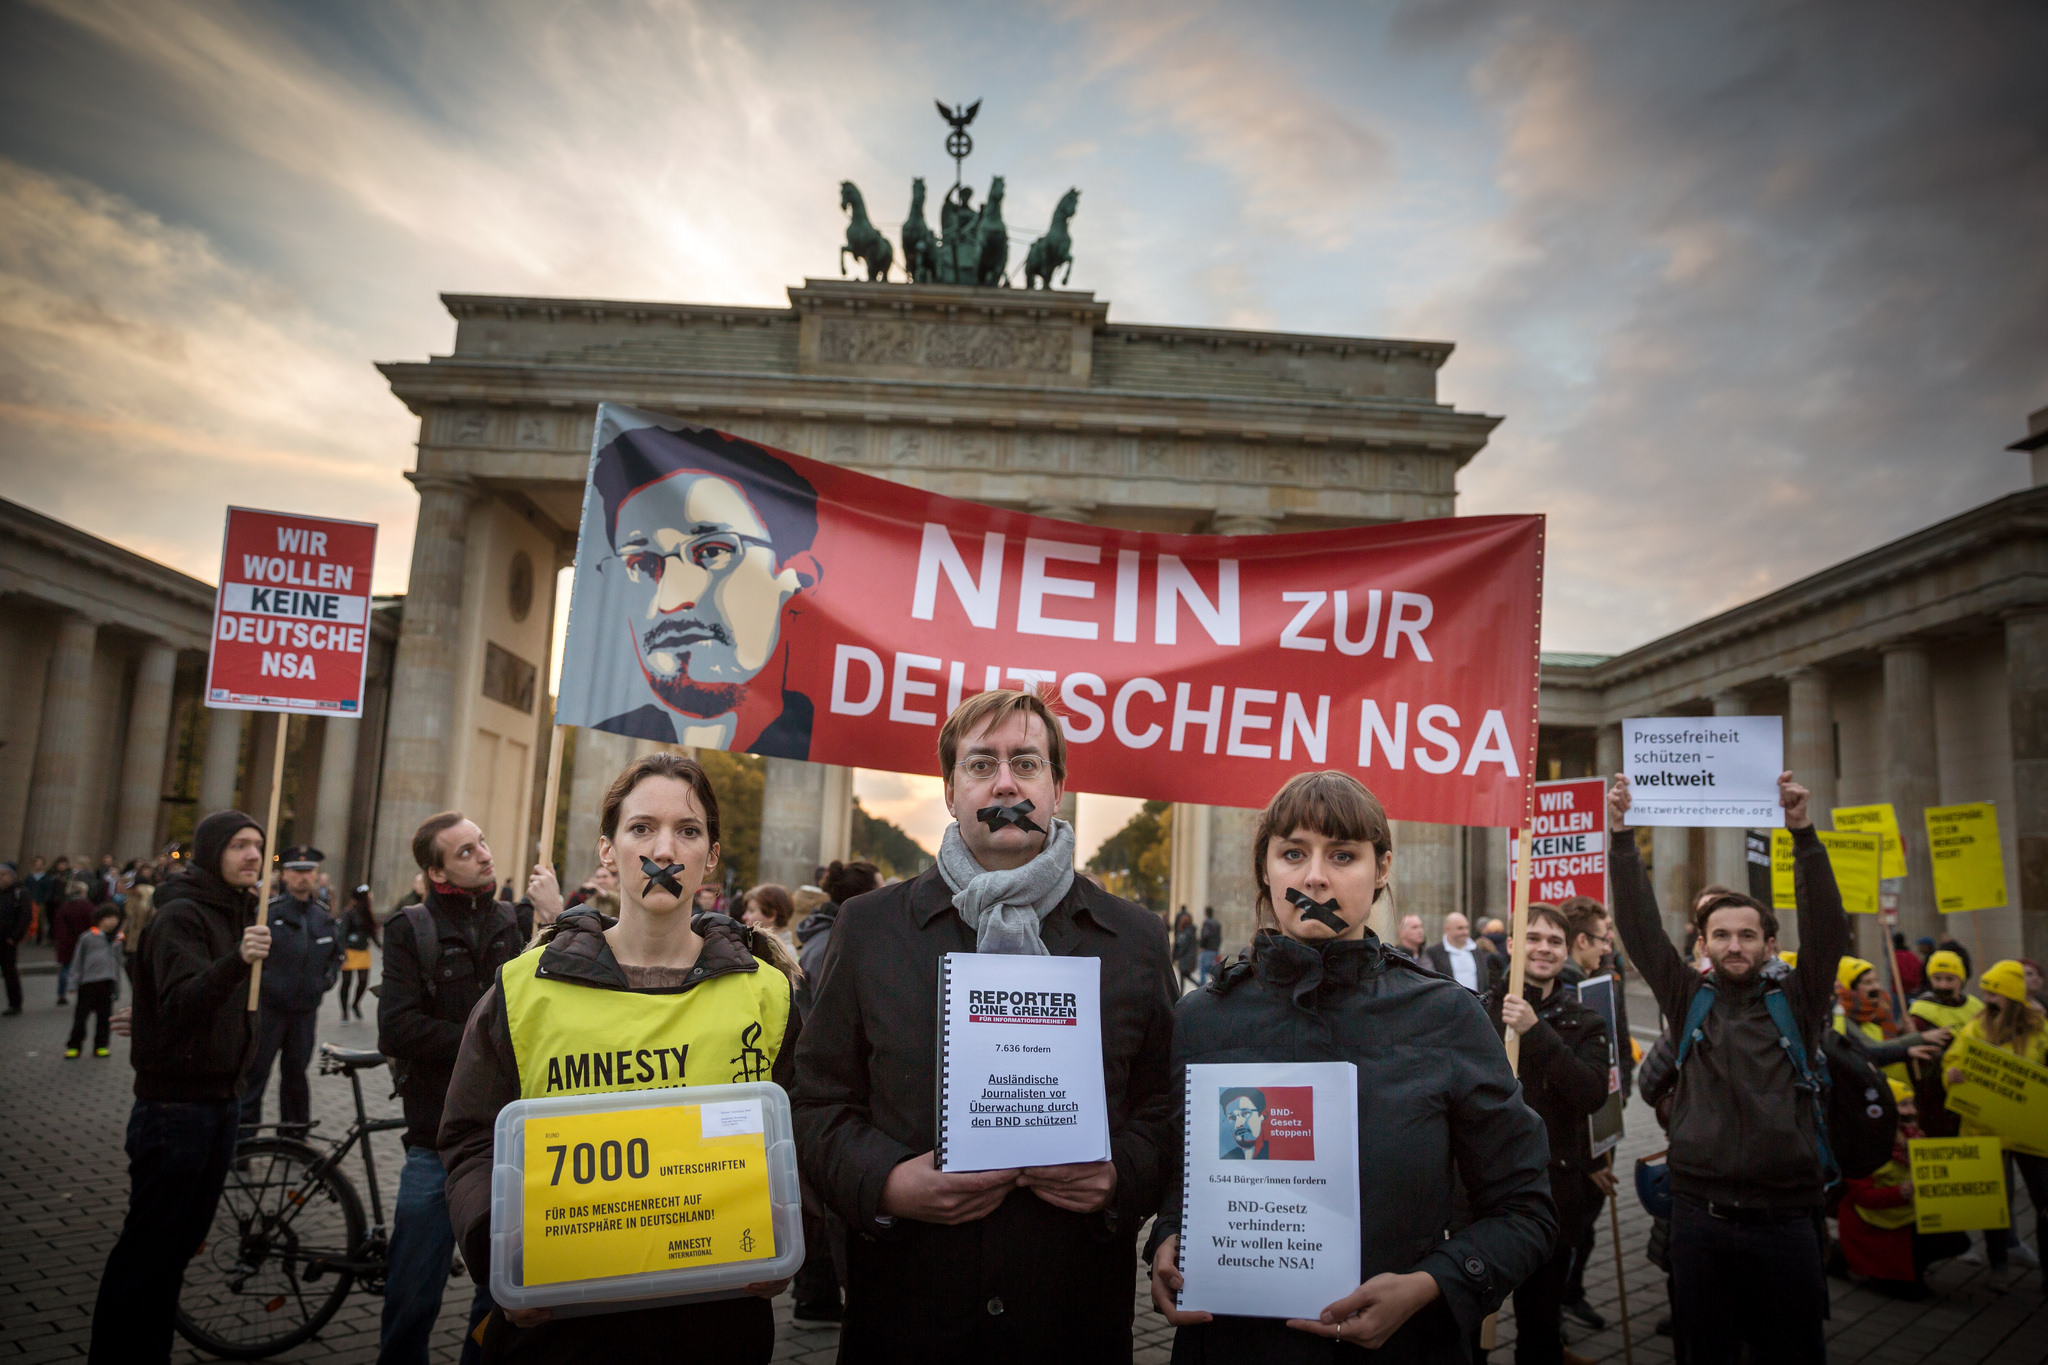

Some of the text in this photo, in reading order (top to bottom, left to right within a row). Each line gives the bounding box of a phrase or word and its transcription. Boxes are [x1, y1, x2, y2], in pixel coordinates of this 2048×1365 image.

[277, 526, 327, 557] WIR
[243, 554, 353, 590] WOLLEN
[911, 522, 1434, 663] NEIN ZUR
[251, 587, 340, 619] KEINE
[218, 615, 364, 653] DEUTSCHE
[260, 651, 316, 680] NSA
[1357, 698, 1521, 777] NSA
[1634, 729, 1740, 744] Pressefreiheit
[1634, 750, 1701, 763] schützen
[1634, 770, 1716, 786] weltweit
[1539, 791, 1575, 812] WIR
[1633, 805, 1773, 818] netzwerkrecherche.org
[1531, 835, 1586, 857] KEINE
[1540, 879, 1576, 900] NSA
[969, 990, 1077, 1007] REPORTER
[969, 1004, 1077, 1018] OHNE GRENZEN
[993, 1016, 1067, 1024] INFORMATIONSFREIHEIT
[995, 1044, 1051, 1053] 7.636 fordern
[546, 1044, 689, 1093] AMNESTY
[988, 1073, 1059, 1085] Ausländische
[981, 1088, 1066, 1099] Journalisten vor
[969, 1100, 1079, 1113] Überwachung durch
[1270, 1108, 1294, 1116] BND-
[971, 1114, 1077, 1126] den BND schützen!
[1270, 1118, 1303, 1126] Gesetz
[1270, 1129, 1312, 1138] stoppen!
[546, 1137, 746, 1187] 7000 UNTERSCHRIFTEN
[1209, 1174, 1327, 1186] 6.544 Bürger/innen fordern
[545, 1193, 702, 1221] FÜR DAS MENSCHENRECHT AUF
[1228, 1200, 1308, 1214] BND-Gesetz
[545, 1208, 715, 1238] PRIVATSPHÄRE IN DEUTSCHLAND!
[1228, 1219, 1306, 1233] verhindern:
[668, 1236, 712, 1252] AMNESTY
[1212, 1236, 1323, 1251] Wir wollen keine
[668, 1248, 713, 1260] INTERNATIONAL
[1218, 1254, 1315, 1270] deutsche NSA!
